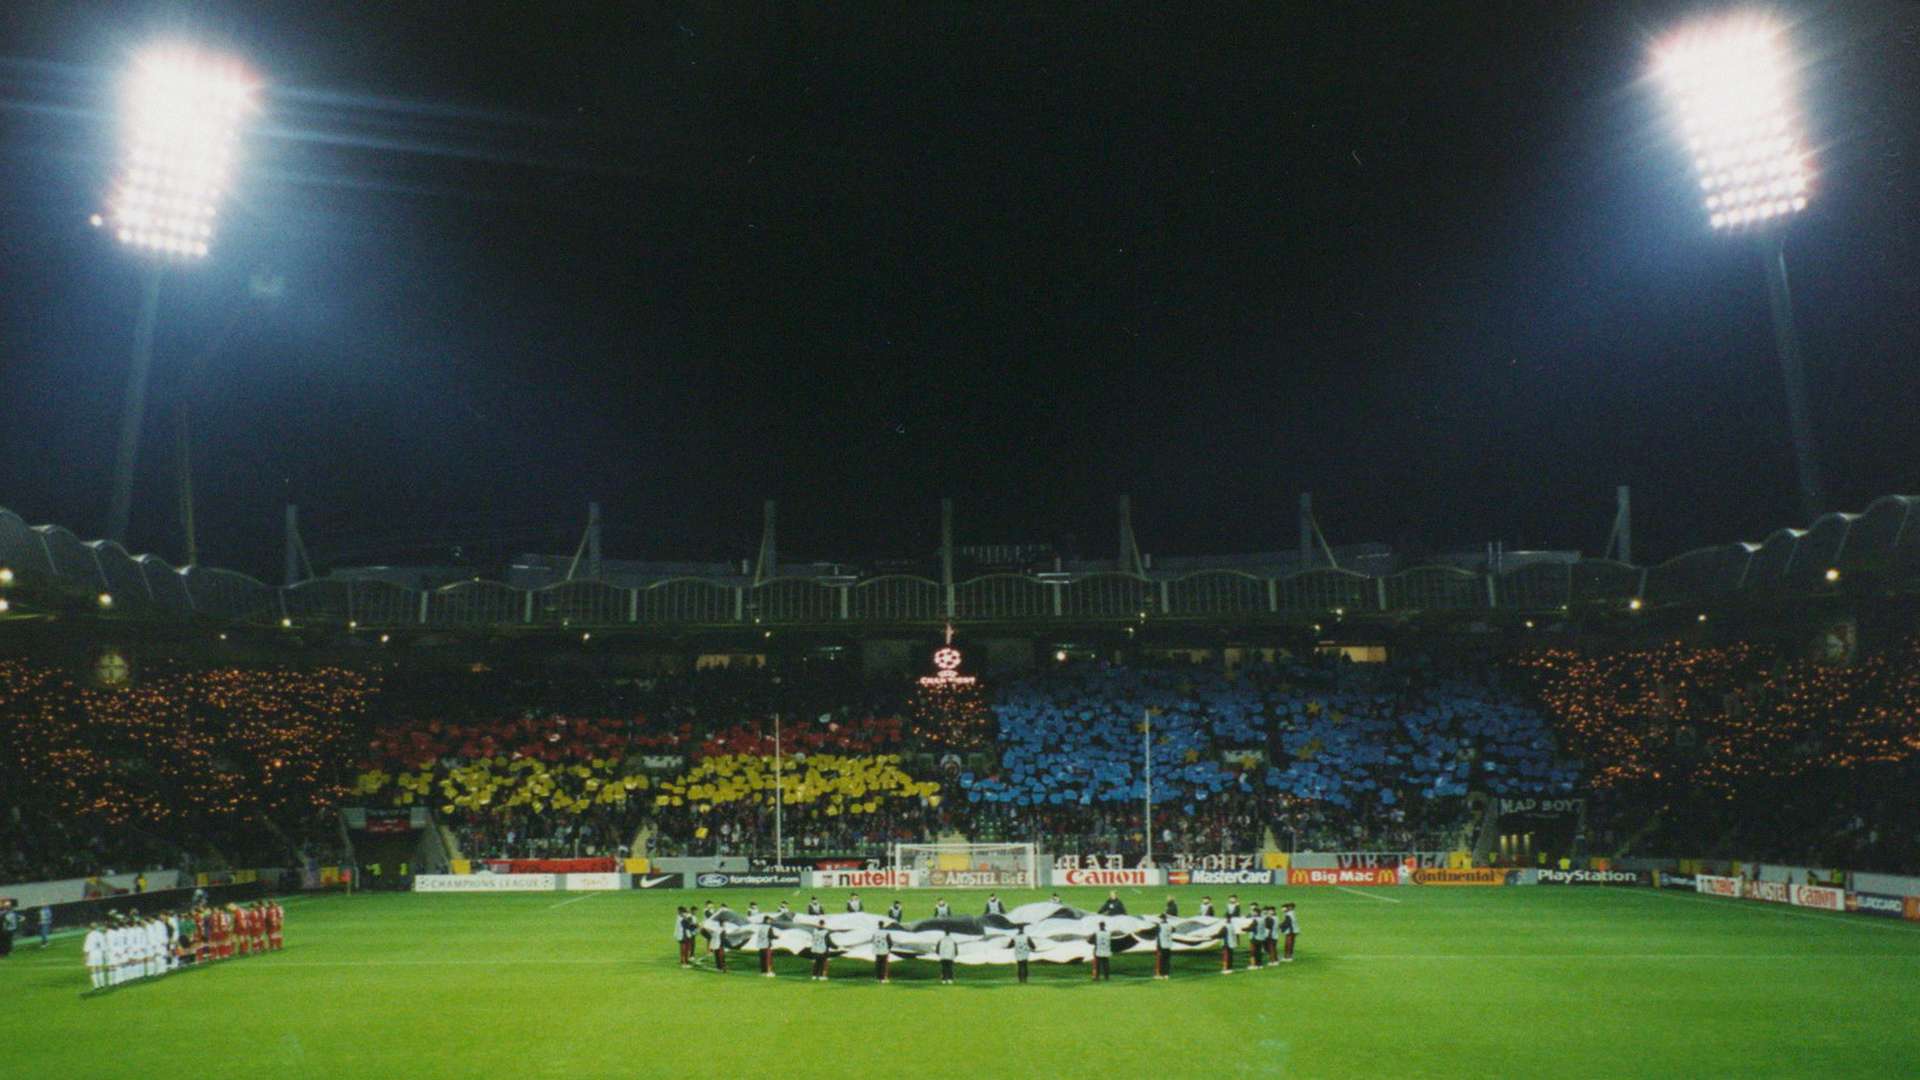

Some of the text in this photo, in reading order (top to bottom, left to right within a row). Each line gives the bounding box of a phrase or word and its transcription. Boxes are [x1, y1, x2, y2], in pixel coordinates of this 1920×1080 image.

[431, 879, 539, 888] CHAMPIONS LEAGUE
[839, 870, 910, 887] nutella
[1066, 869, 1146, 885] Canon
[1192, 870, 1272, 885] MasterCard
[1312, 871, 1337, 883] Big
[1340, 870, 1374, 882] Mac
[1413, 869, 1496, 885] Continental
[1537, 869, 1637, 884] PlayStation
